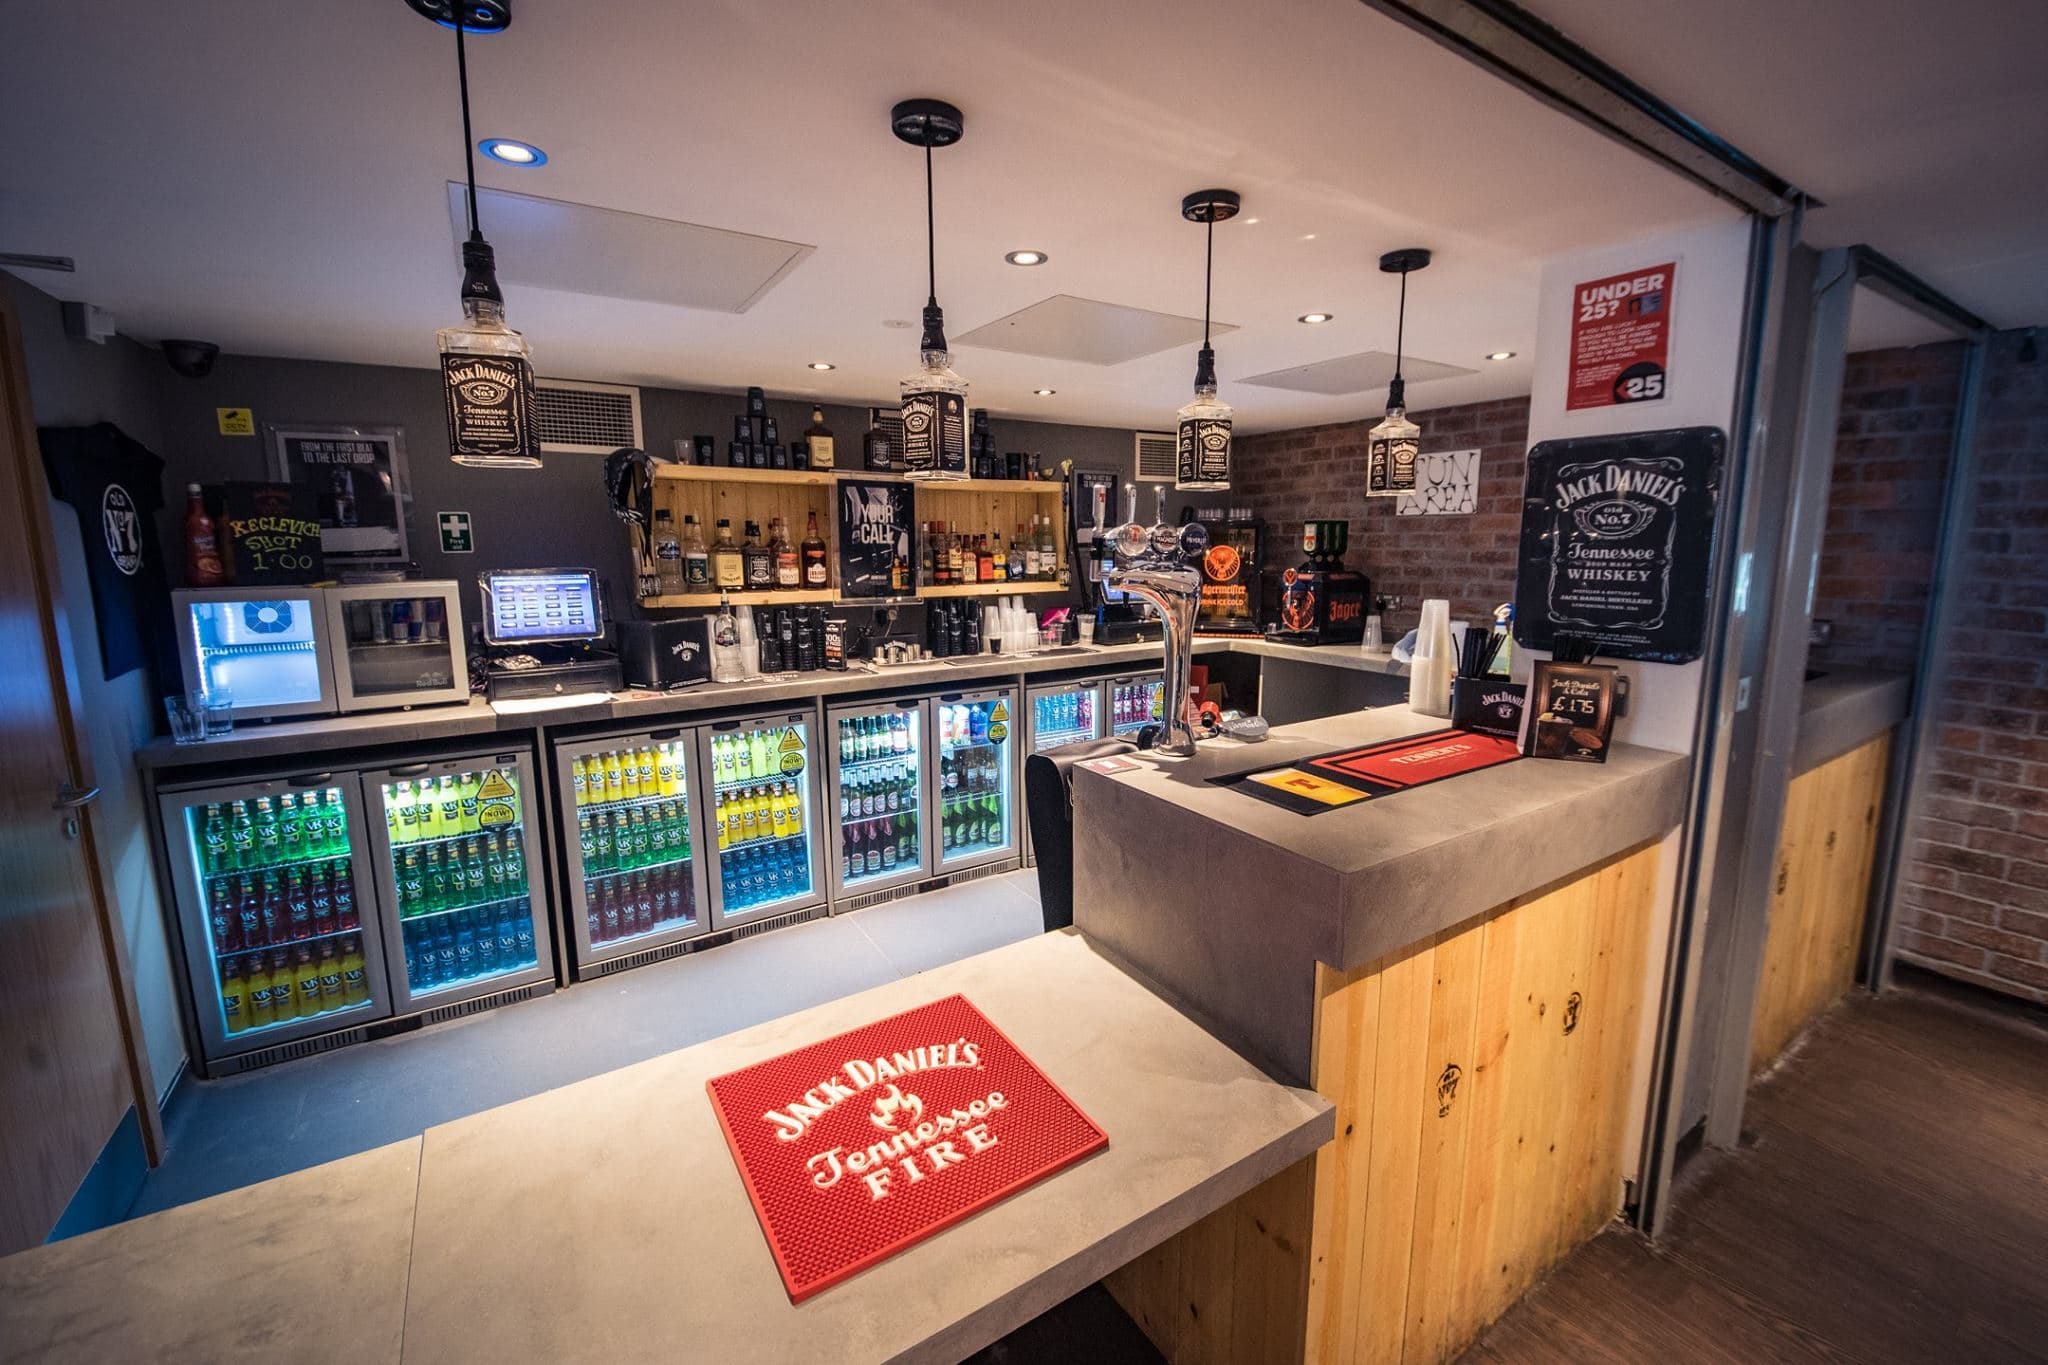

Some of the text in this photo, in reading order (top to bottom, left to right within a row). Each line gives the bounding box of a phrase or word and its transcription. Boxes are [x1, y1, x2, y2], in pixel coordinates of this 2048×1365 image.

[1581, 273, 1665, 305] UNDER
[1580, 300, 1620, 323] 25?
[448, 364, 518, 389] JACK DANIEL'S
[1626, 373, 1663, 399] 25
[463, 404, 508, 415] Tennessee
[465, 418, 509, 427] WHISKEY
[301, 441, 320, 451] FROM
[321, 441, 335, 451] THE
[335, 442, 354, 452] FIRST
[302, 452, 375, 464] TO THE LAST DROP
[1556, 465, 1687, 509] JACK DANIEL'S
[1400, 484, 1479, 515] AREA
[860, 503, 894, 523] YOUR
[1594, 513, 1632, 525] No.7
[230, 517, 321, 538] KEGLEVICH
[861, 523, 895, 544] CALL
[245, 535, 302, 549] SHOT
[1567, 542, 1655, 559] Tennessee
[1567, 568, 1651, 582] WHISKEY
[1202, 584, 1247, 595] ägermeister
[1552, 679, 1570, 688] Jack
[1571, 688, 1589, 696] Cola
[1482, 694, 1501, 706] JACK
[281, 824, 296, 833] VK
[306, 821, 322, 831] VK
[233, 831, 249, 841] VK
[259, 828, 276, 837] VK
[668, 830, 680, 838] VK
[207, 835, 224, 844] VK
[619, 840, 630, 848] VK
[581, 841, 594, 849] VK
[506, 863, 518, 872] VK
[470, 870, 484, 879] VK
[406, 881, 421, 890] VK
[313, 898, 330, 908] VK
[335, 894, 351, 904] VK
[290, 903, 307, 912] VK
[623, 905, 635, 913] VK
[639, 902, 651, 911] VK
[240, 912, 257, 920] VK
[606, 910, 618, 919] VK
[324, 975, 339, 985] VK
[762, 1036, 981, 1144] JACK DANIEL'S
[806, 1089, 1009, 1189] Tennessee
[862, 1123, 999, 1203] FIRE
